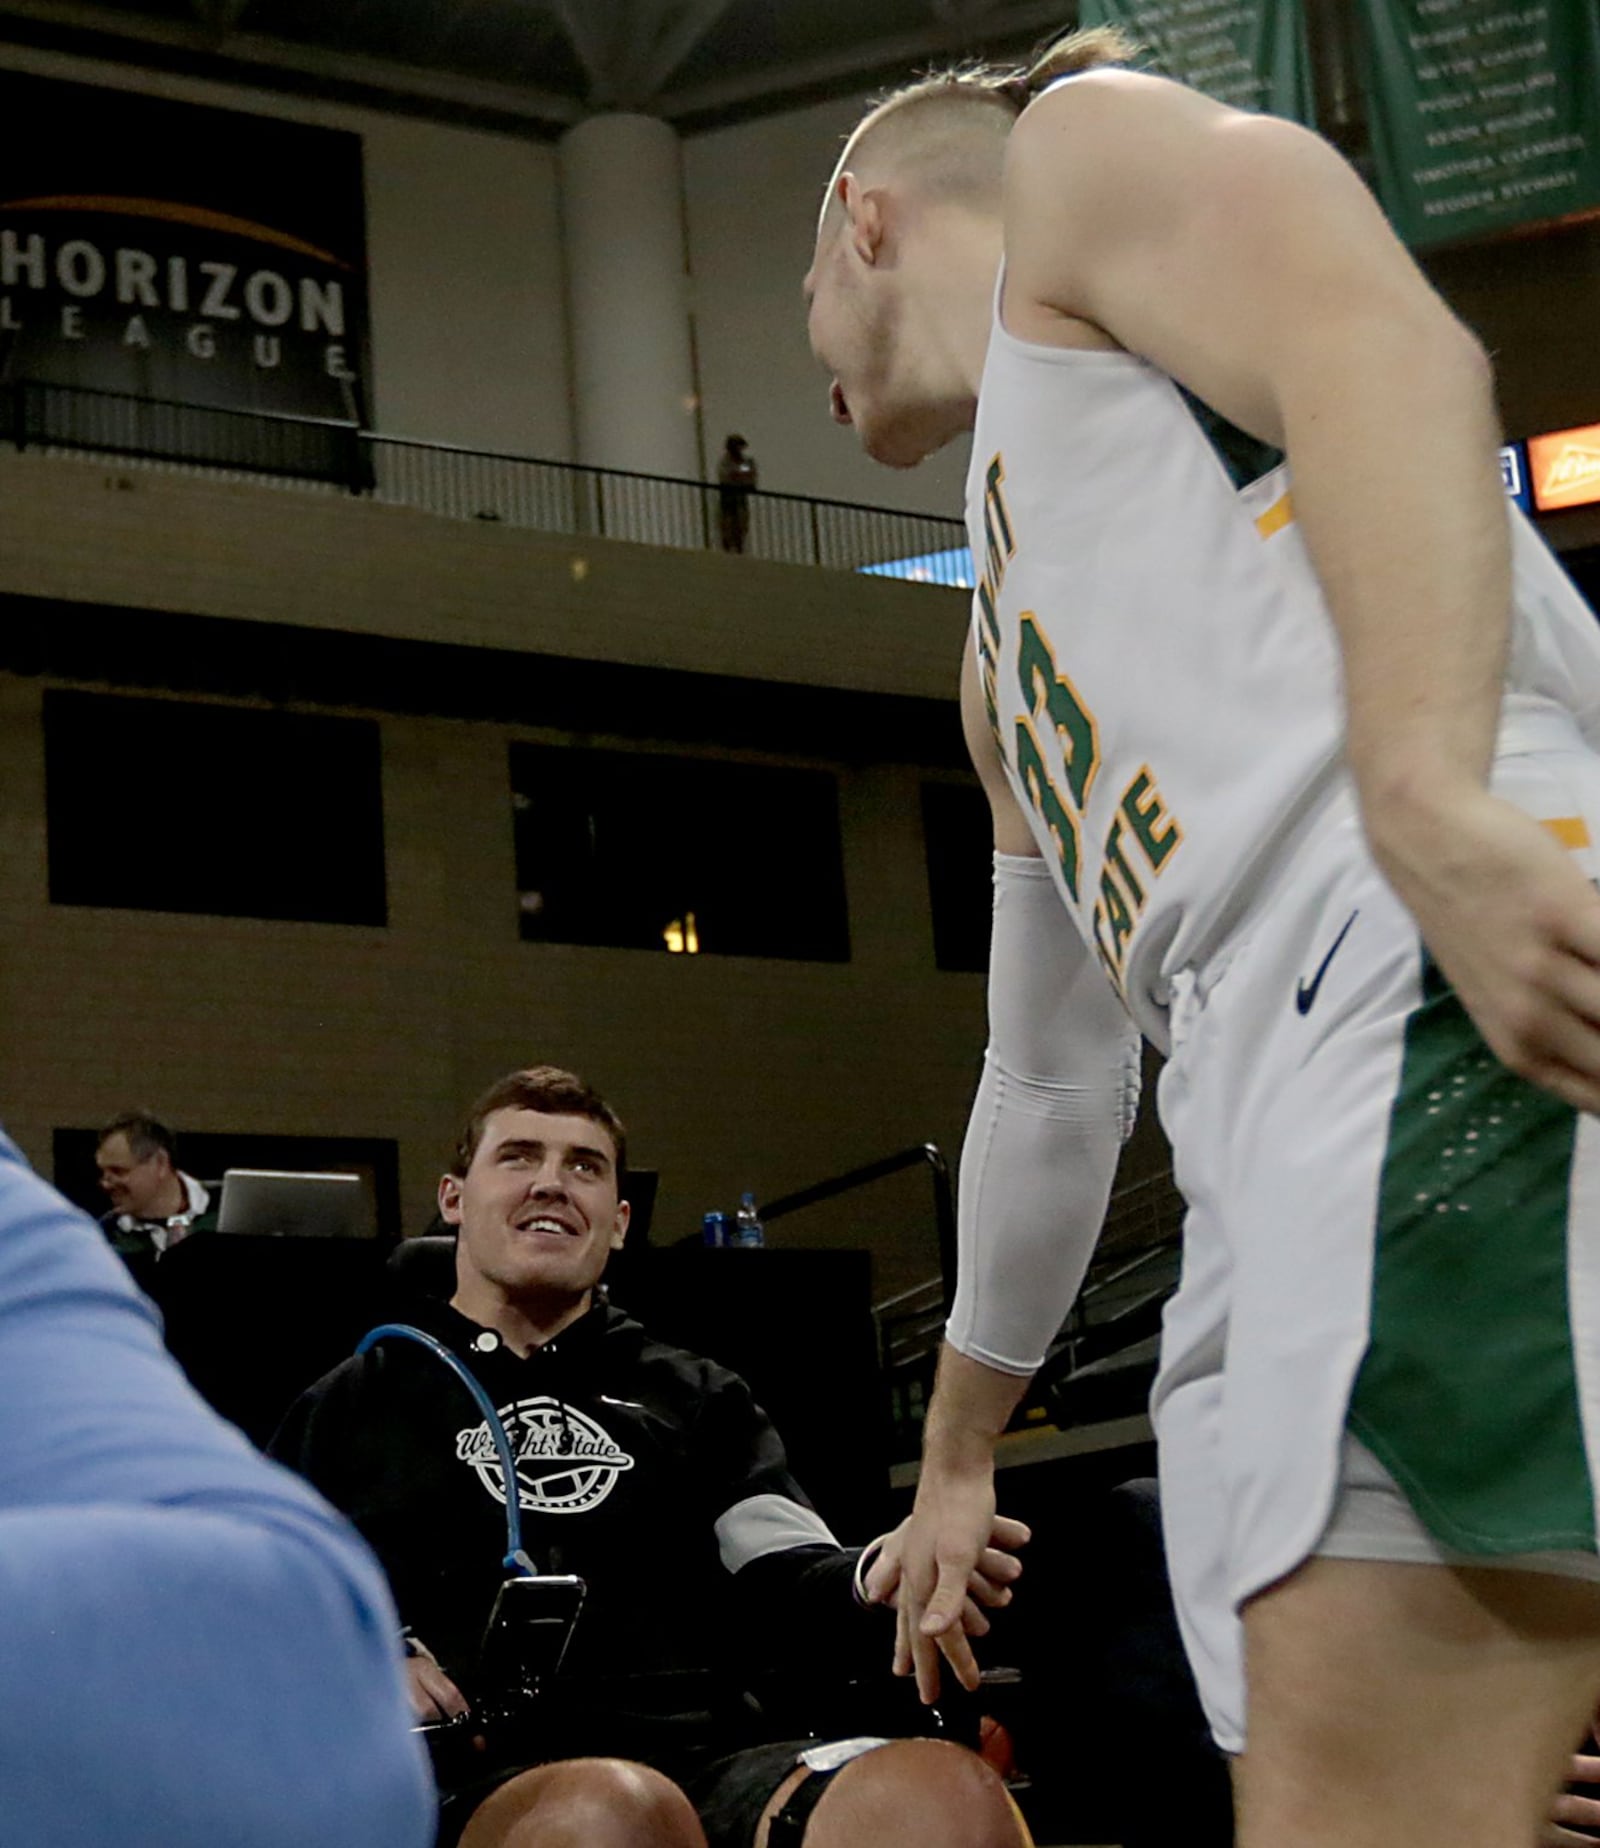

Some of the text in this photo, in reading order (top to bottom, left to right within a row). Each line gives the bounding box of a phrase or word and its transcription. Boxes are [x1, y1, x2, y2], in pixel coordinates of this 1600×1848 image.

[0, 228, 345, 336] HORIZON
[0, 297, 352, 378] LEAGUE
[1094, 763, 1184, 1016] TATE
